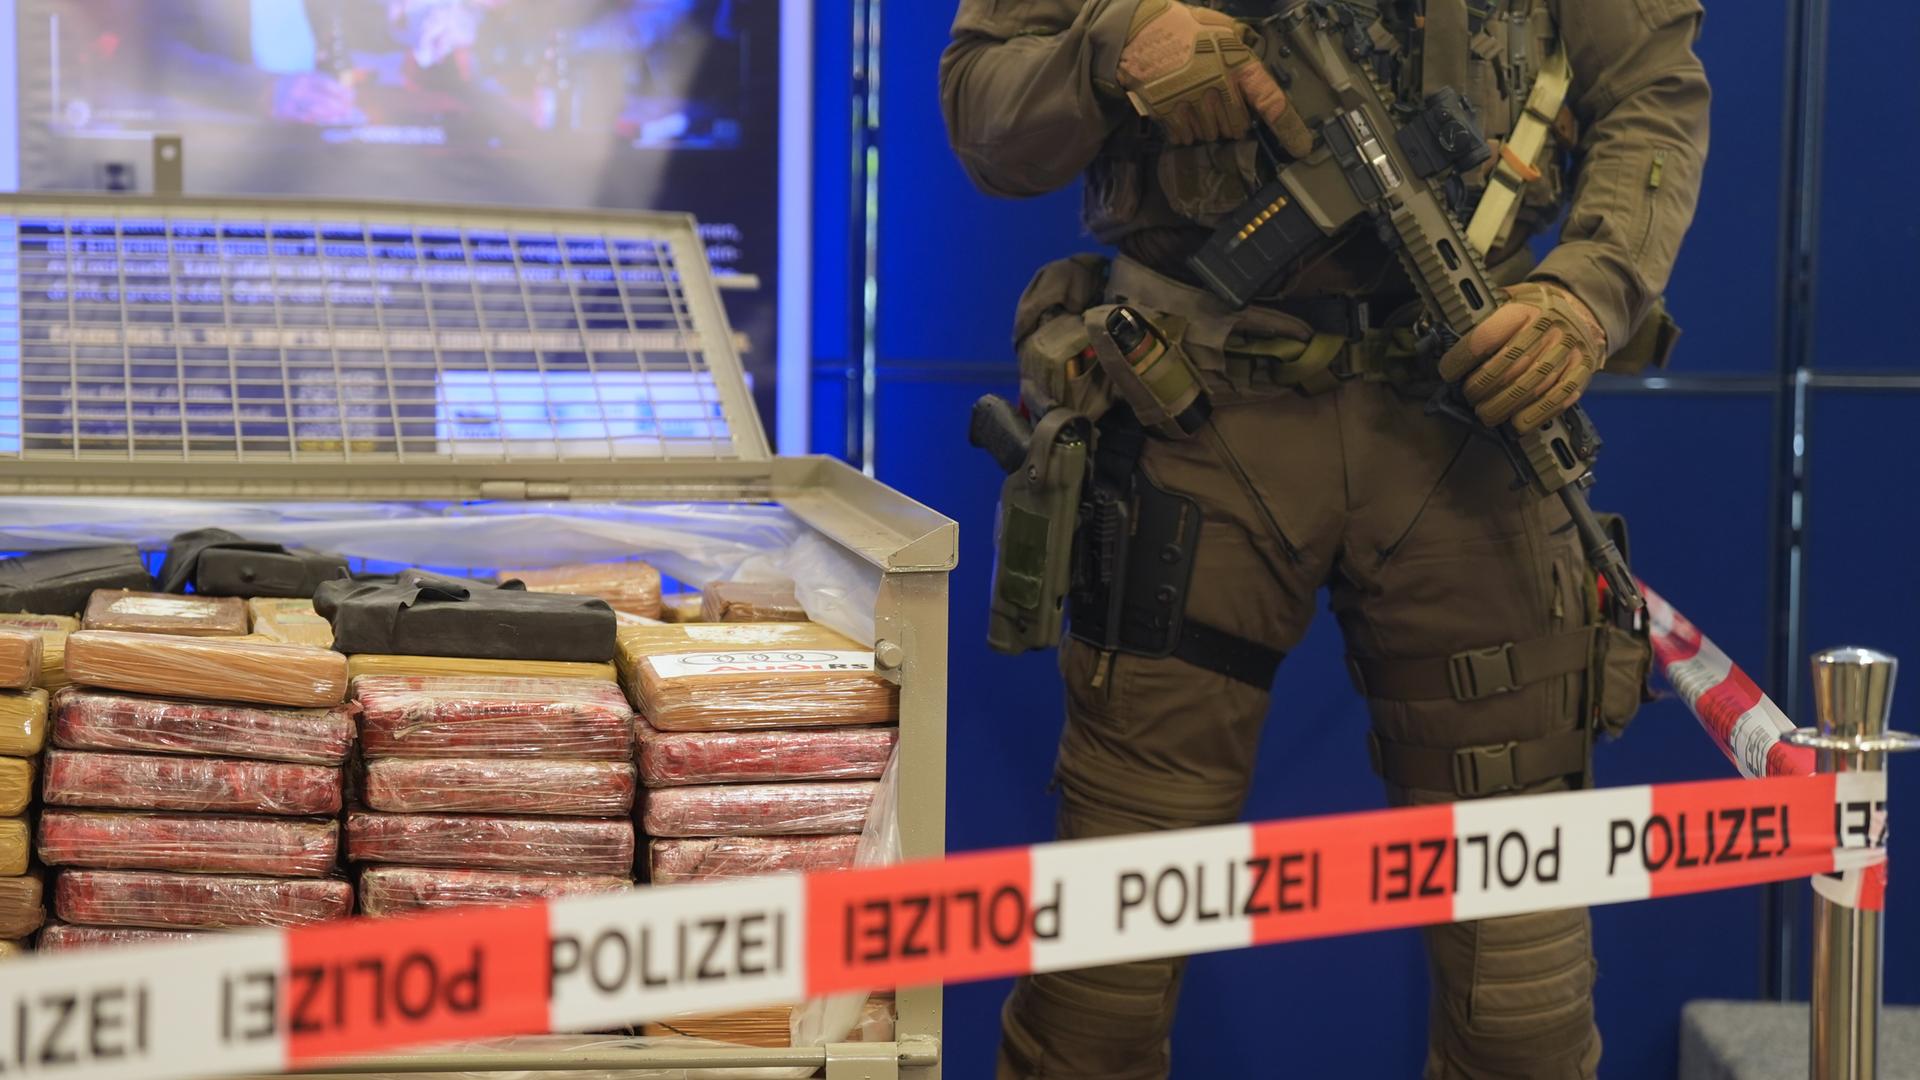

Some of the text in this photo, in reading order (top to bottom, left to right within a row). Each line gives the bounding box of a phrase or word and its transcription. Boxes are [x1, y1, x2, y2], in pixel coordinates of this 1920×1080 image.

[828, 662, 869, 671] RS
[0, 982, 149, 1074] IZEI
[221, 946, 484, 1045] POLIZEI
[549, 911, 786, 999] POLIZEI
[843, 879, 1065, 968] POLIZEI
[1117, 851, 1320, 934] POLIZEI
[1371, 826, 1561, 905] POLIZEI
[1607, 805, 1791, 875] POLIZEI
